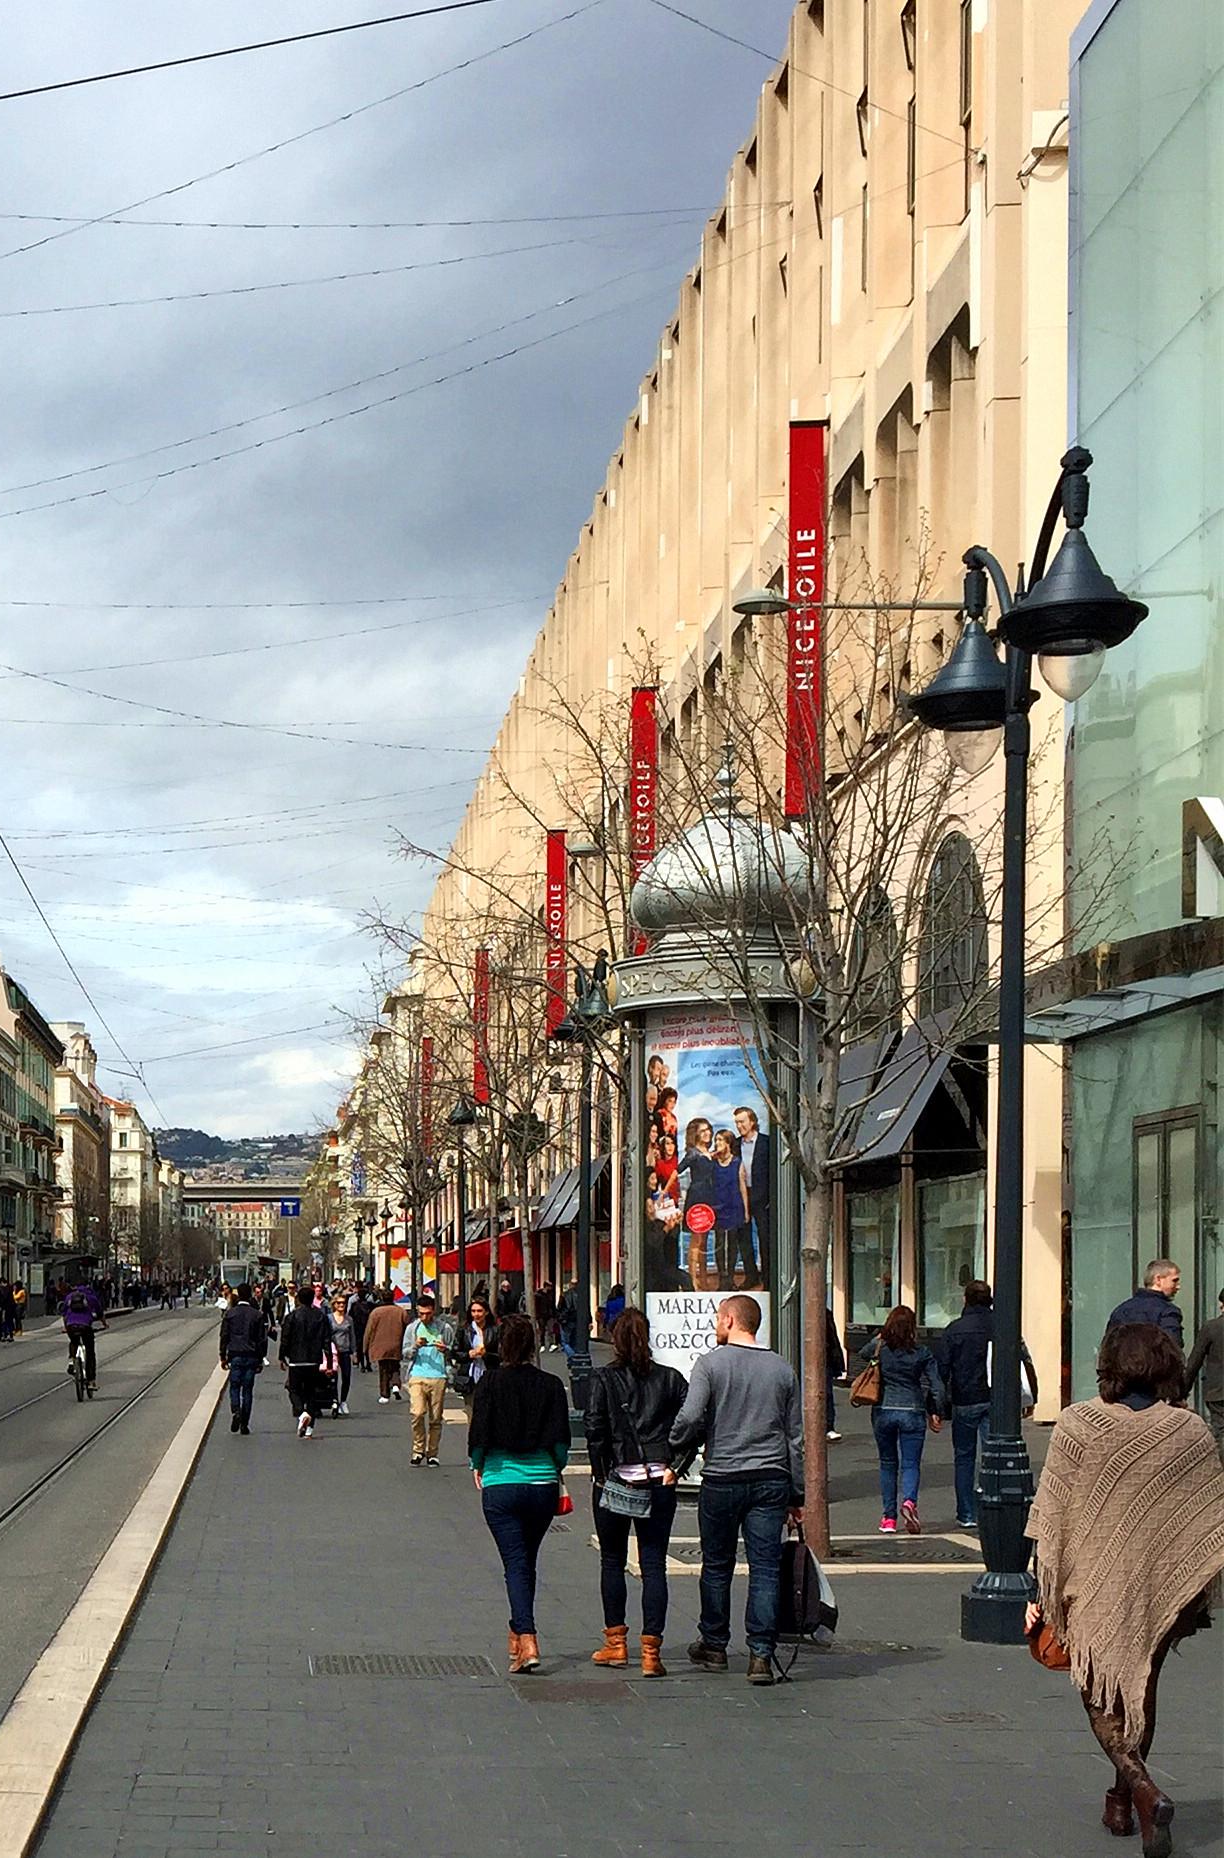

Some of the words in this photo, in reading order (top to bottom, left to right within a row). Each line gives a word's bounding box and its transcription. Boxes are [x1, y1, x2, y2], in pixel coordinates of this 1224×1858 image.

[794, 527, 817, 691] NICEOILE
[682, 1039, 700, 1049] plus
[657, 1298, 727, 1315] MARIA
[696, 1318, 716, 1331] LA
